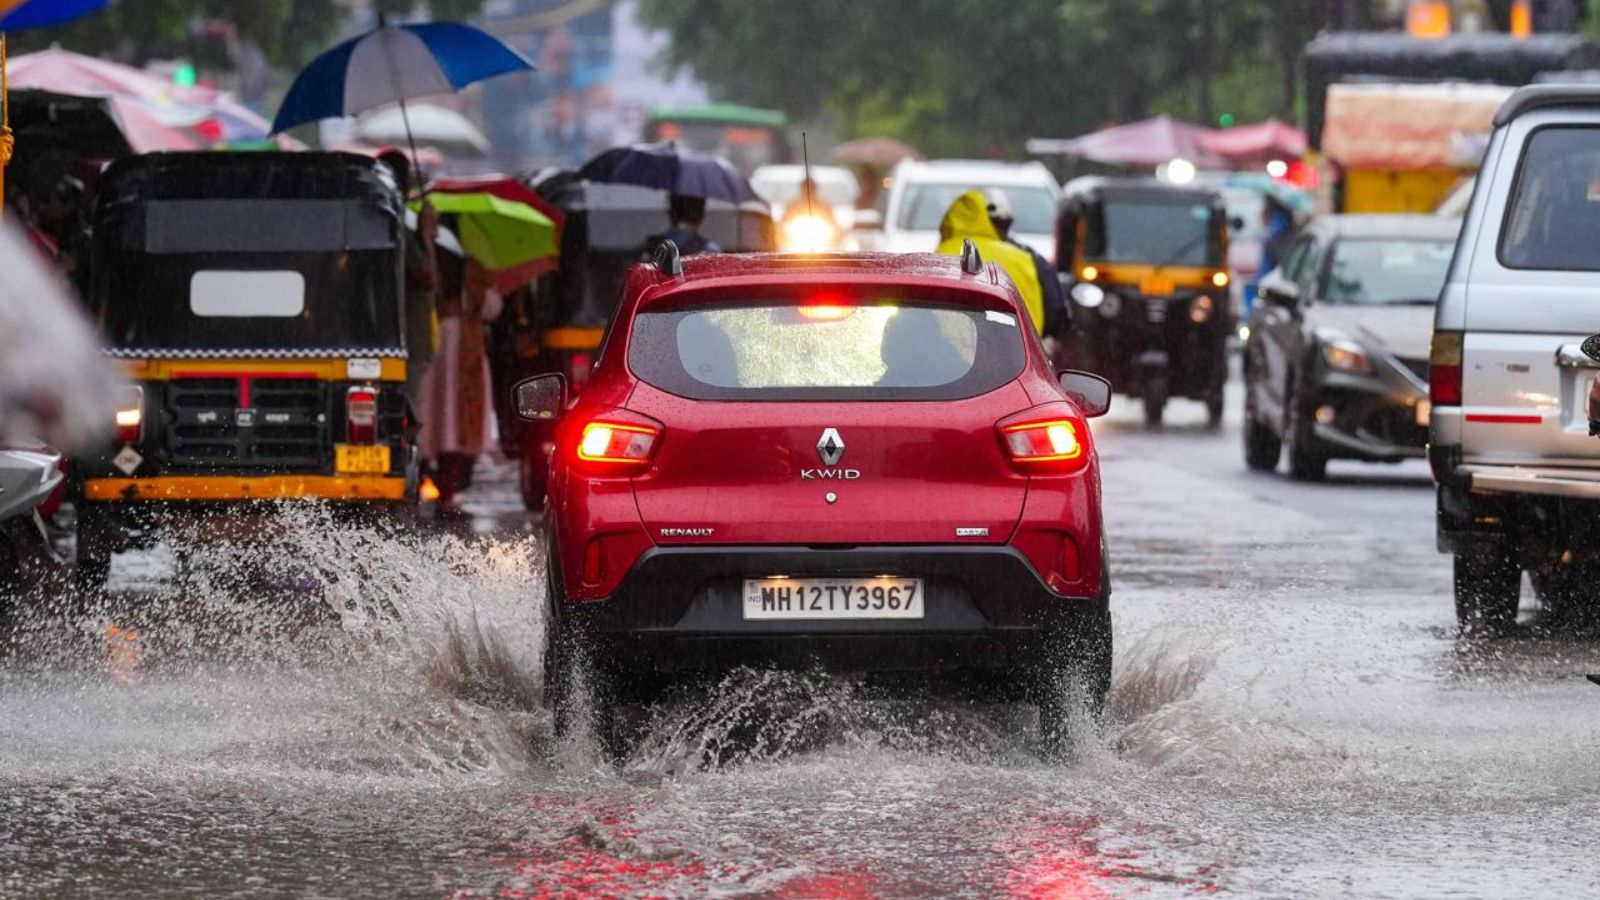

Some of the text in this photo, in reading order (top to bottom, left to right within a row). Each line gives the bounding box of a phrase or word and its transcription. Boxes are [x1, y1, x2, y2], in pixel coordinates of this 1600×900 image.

[801, 469, 860, 479] KWID
[660, 528, 715, 537] RENAULT
[761, 586, 917, 611] MH12TY3967
